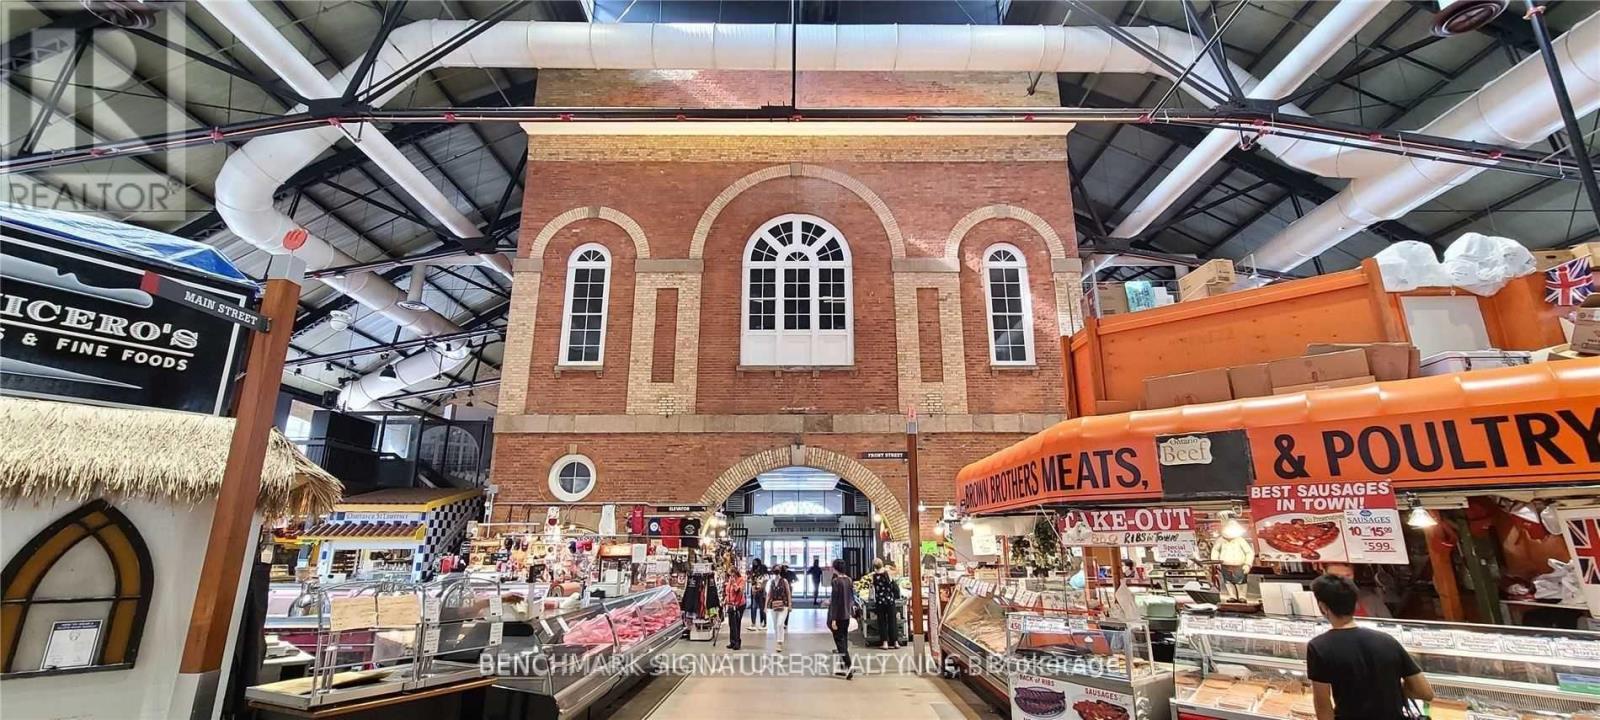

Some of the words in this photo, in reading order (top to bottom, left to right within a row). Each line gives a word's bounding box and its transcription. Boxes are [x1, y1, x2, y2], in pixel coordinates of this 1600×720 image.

[184, 291, 215, 310] MAIN
[217, 303, 258, 325] STREET
[0, 293, 199, 349] ICERO'S
[22, 332, 39, 347] &
[56, 338, 109, 357] FINE
[121, 350, 189, 371] FOODS
[1169, 438, 1198, 446] Ontario
[1162, 440, 1207, 463] Beef
[965, 478, 989, 509] BROWN
[990, 460, 1039, 503] BROTHERS
[1041, 447, 1149, 492] MEATS,
[1273, 434, 1311, 480] &
[1251, 485, 1291, 499] BEST
[1297, 482, 1390, 497] SAUSAGES
[1276, 499, 1295, 511] IN
[1302, 497, 1365, 511] TOWN!
[1347, 516, 1391, 524] SAUSAGES
[1349, 526, 1362, 536] 10
[1042, 678, 1055, 687] RIBS
[1085, 688, 1120, 700] SAUSAGES
